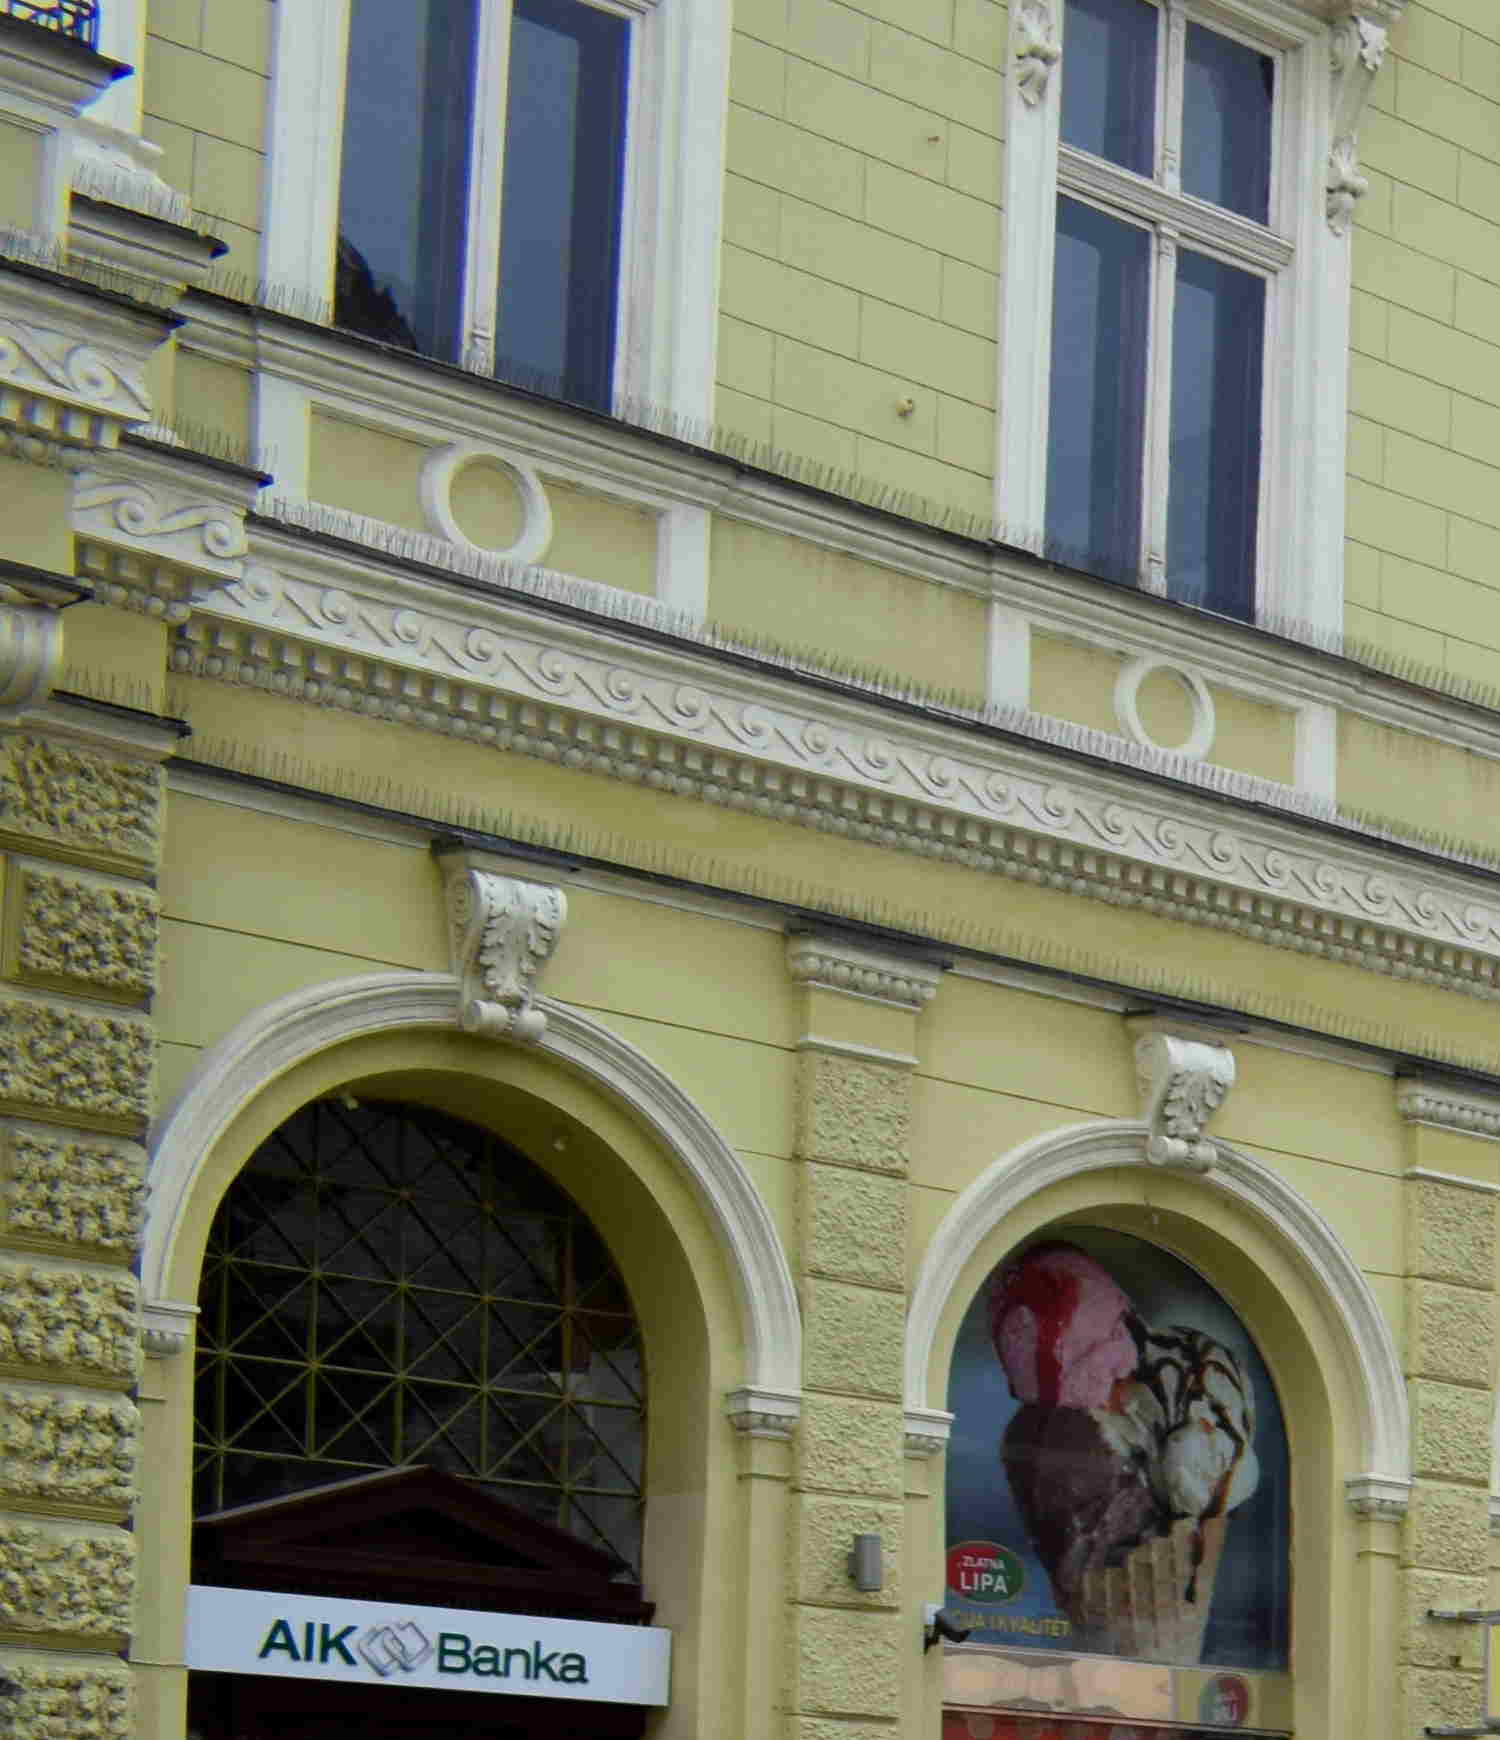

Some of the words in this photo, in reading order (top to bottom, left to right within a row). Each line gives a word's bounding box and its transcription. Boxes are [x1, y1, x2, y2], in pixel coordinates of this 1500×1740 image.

[959, 1571, 1009, 1594] LIPA
[258, 1618, 359, 1667] AIK
[436, 1631, 589, 1686] Banka
